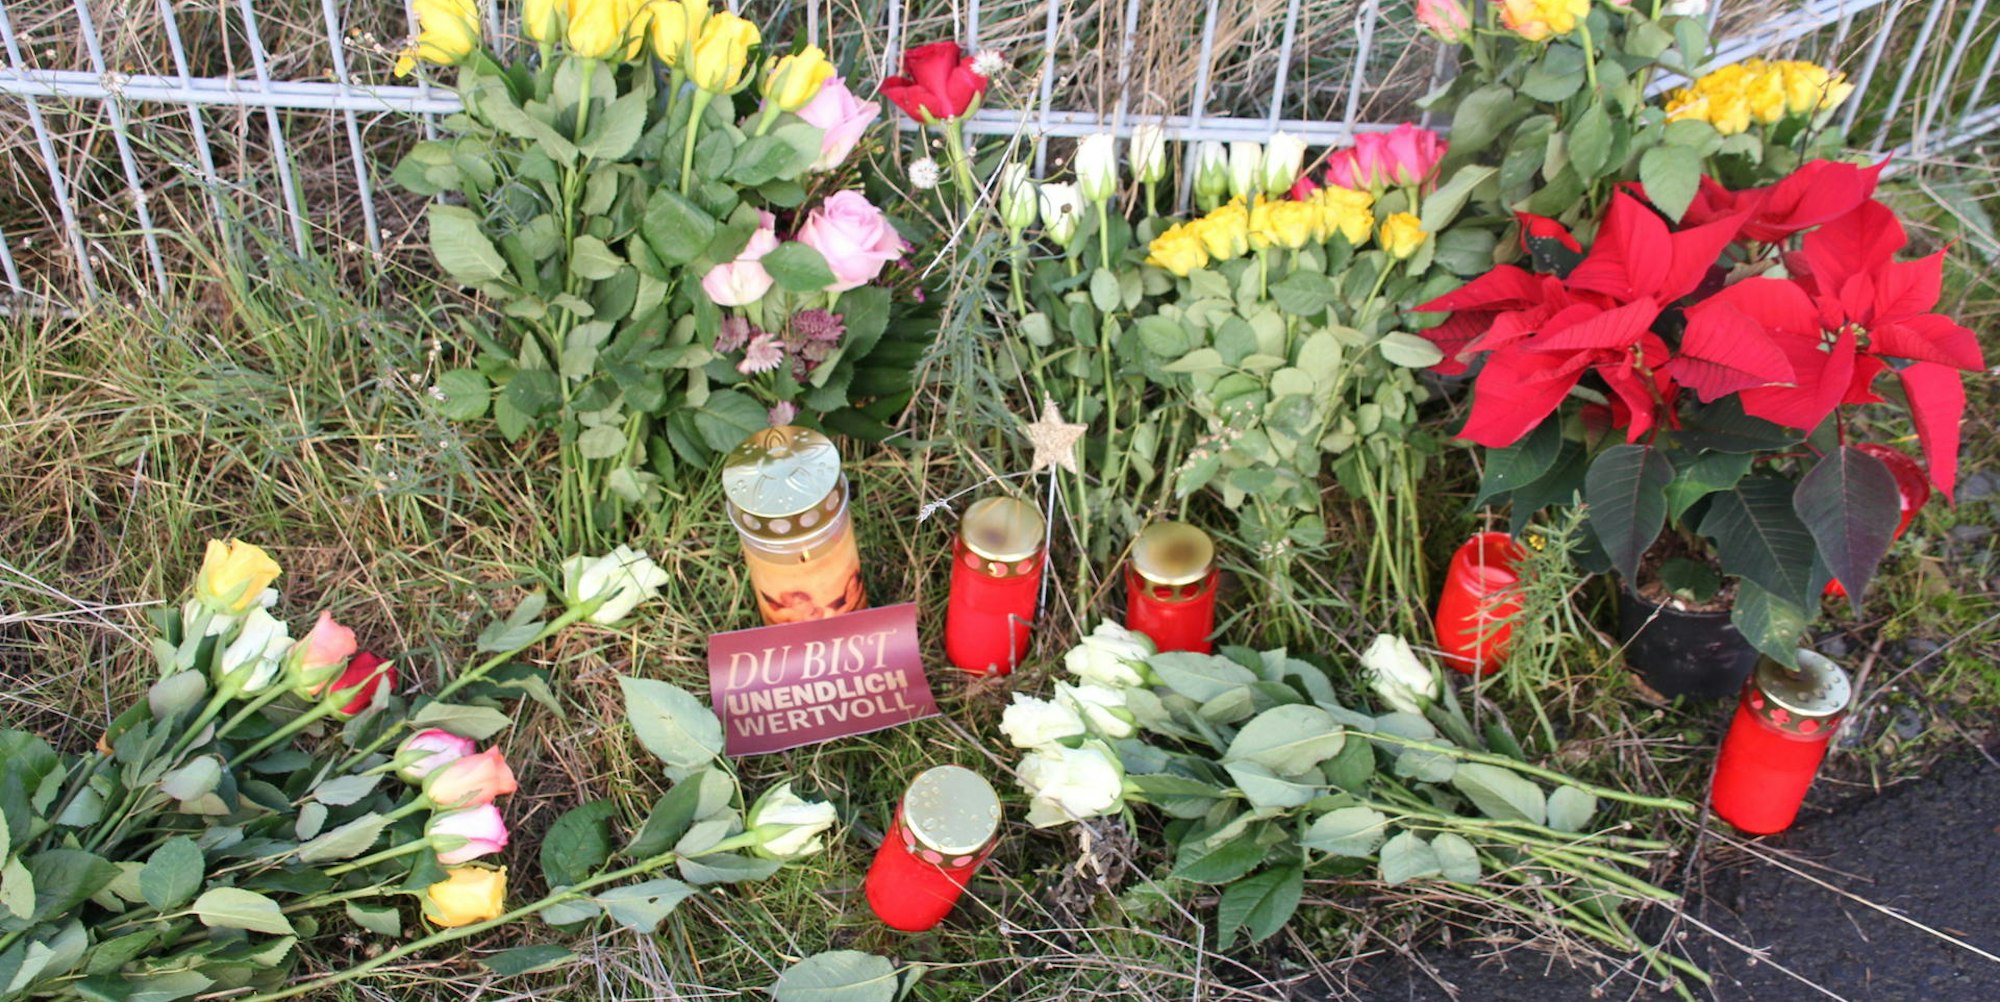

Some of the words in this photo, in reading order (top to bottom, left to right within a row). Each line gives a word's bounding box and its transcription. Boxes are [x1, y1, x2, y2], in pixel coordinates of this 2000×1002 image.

[725, 645, 792, 690] DU
[800, 629, 897, 679] BIST
[727, 669, 908, 715] UNENDLICH
[734, 692, 916, 737] WERTVOLL
